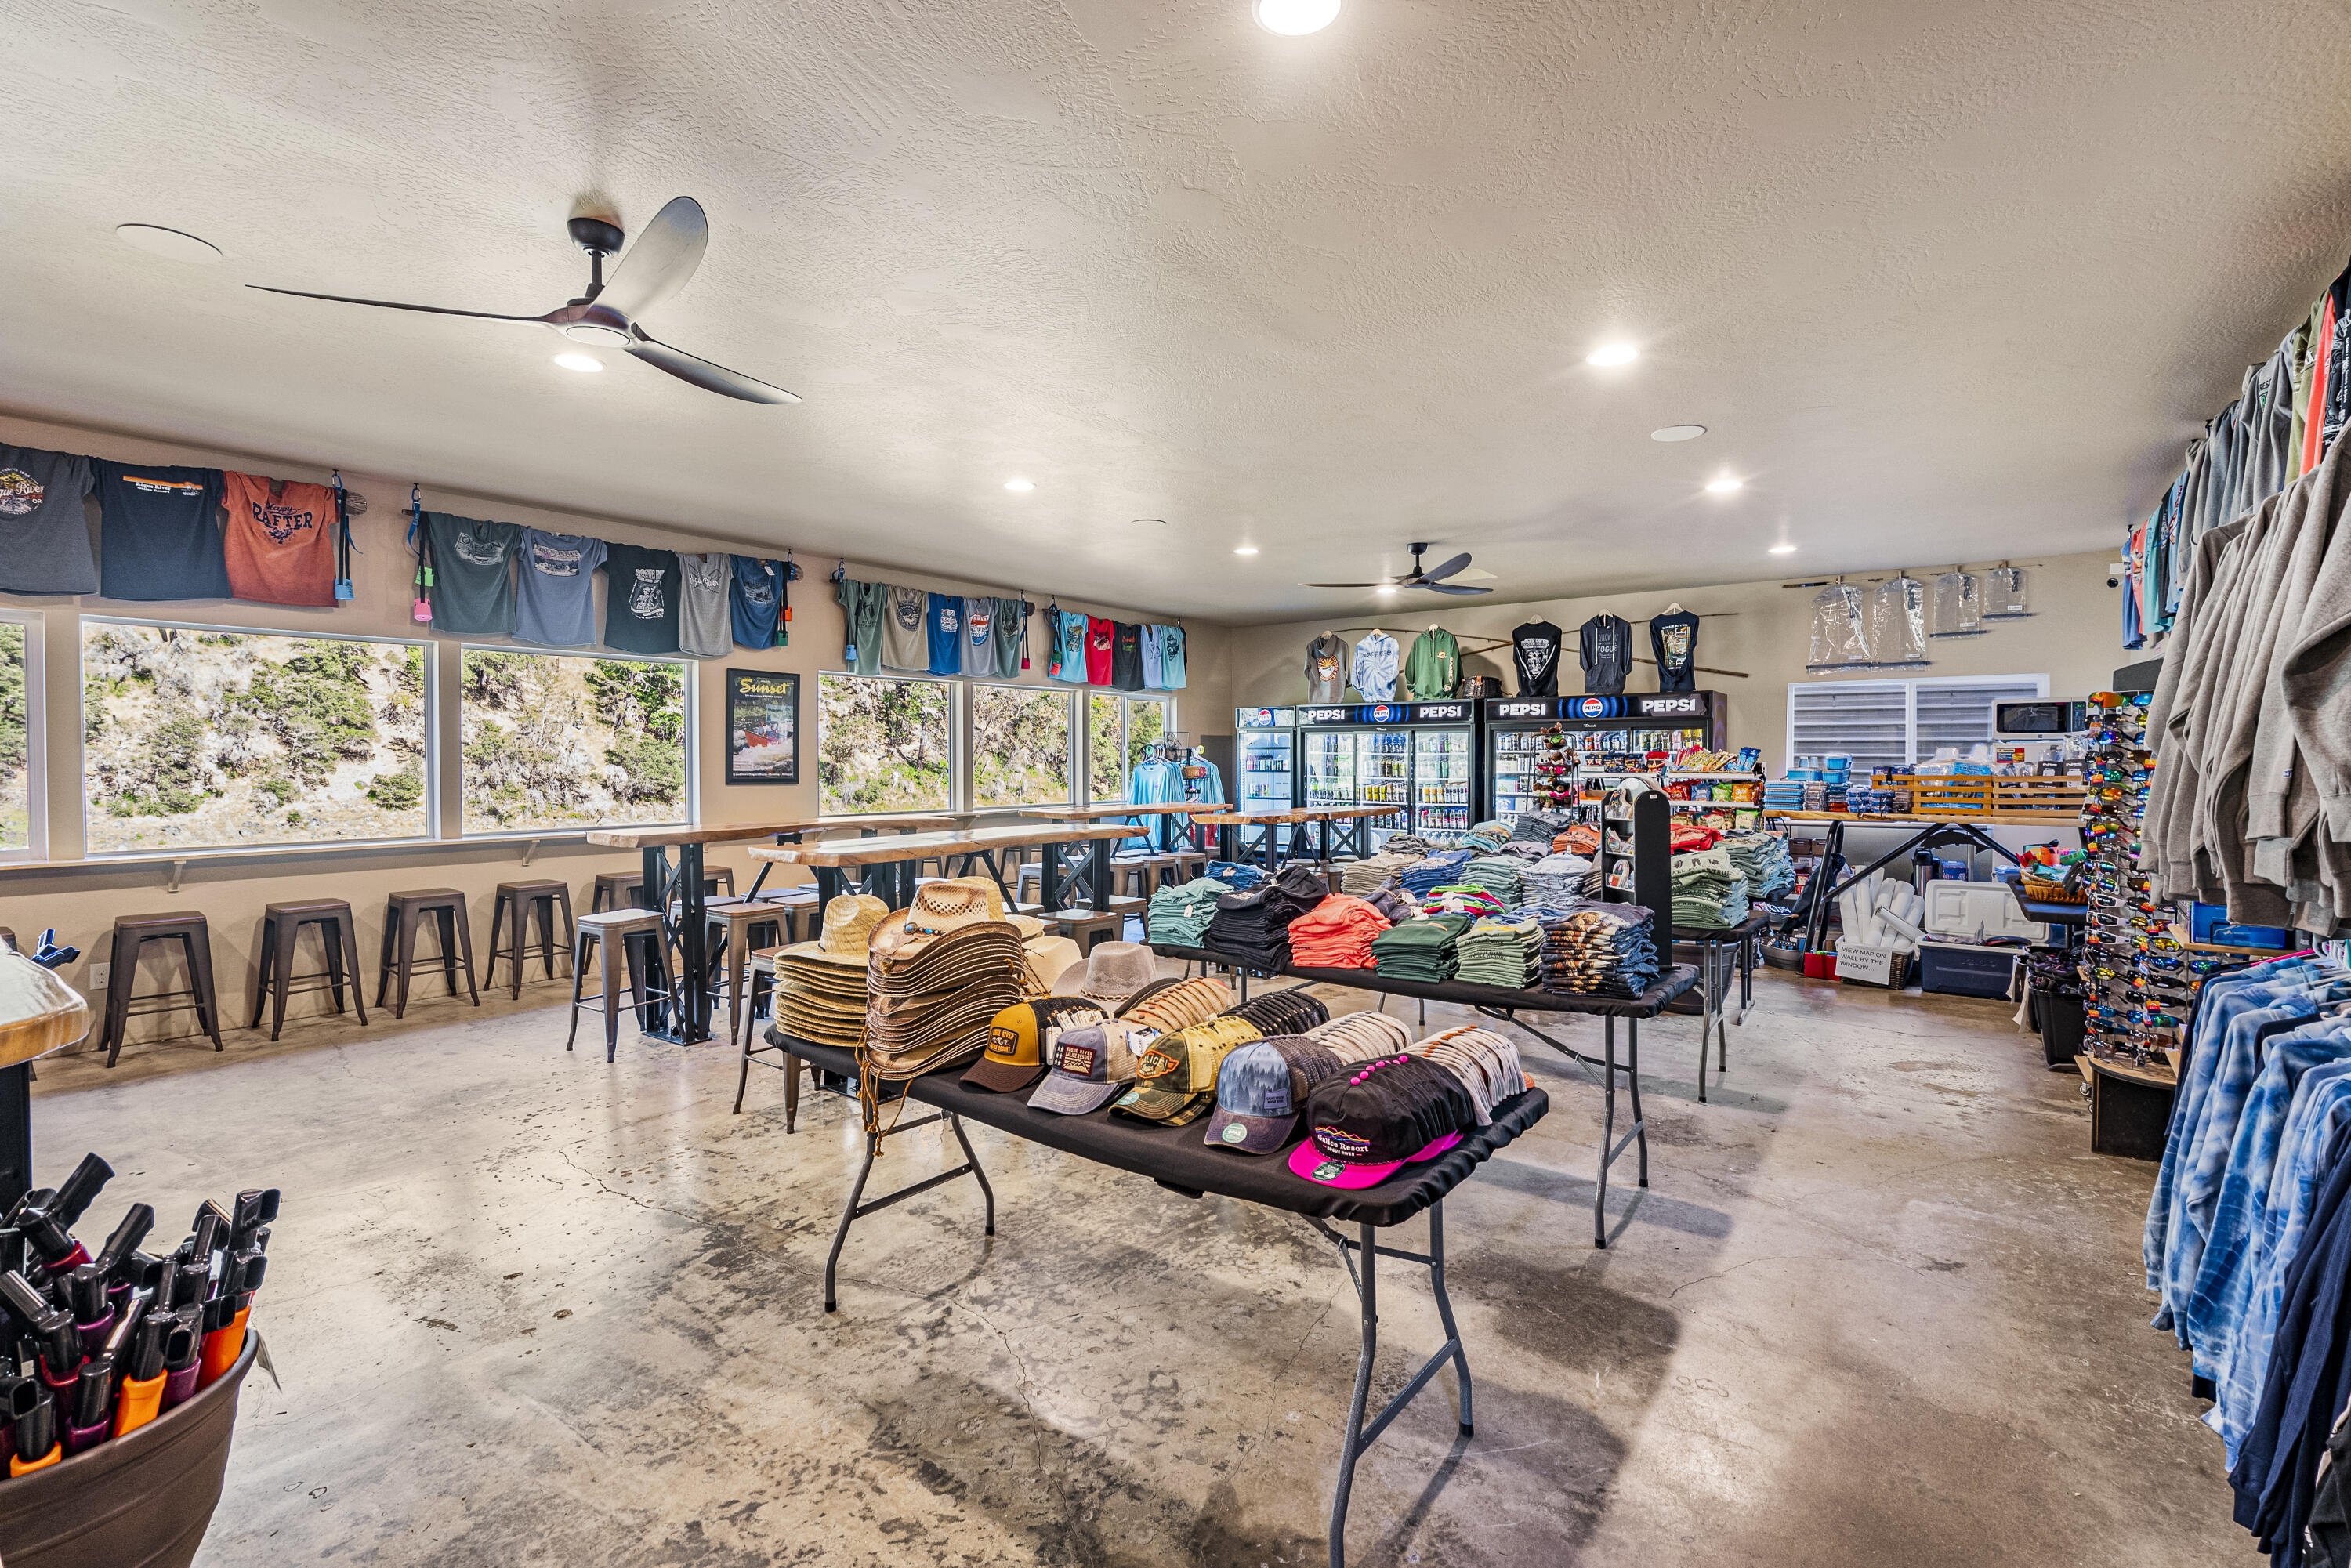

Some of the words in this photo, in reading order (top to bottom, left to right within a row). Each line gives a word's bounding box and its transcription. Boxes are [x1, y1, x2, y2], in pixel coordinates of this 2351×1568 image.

[16, 483, 45, 494] River
[252, 502, 313, 529] RAFTER
[739, 677, 790, 694] Sunset
[1419, 705, 1462, 718] PEPSI
[1499, 703, 1546, 716] PEPSI
[1642, 698, 1696, 712] PEPSI
[1308, 709, 1345, 720] PEPSI
[1317, 1134, 1339, 1148] Galice
[1339, 1143, 1369, 1152] Resort
[1327, 1146, 1341, 1154] ROGUE
